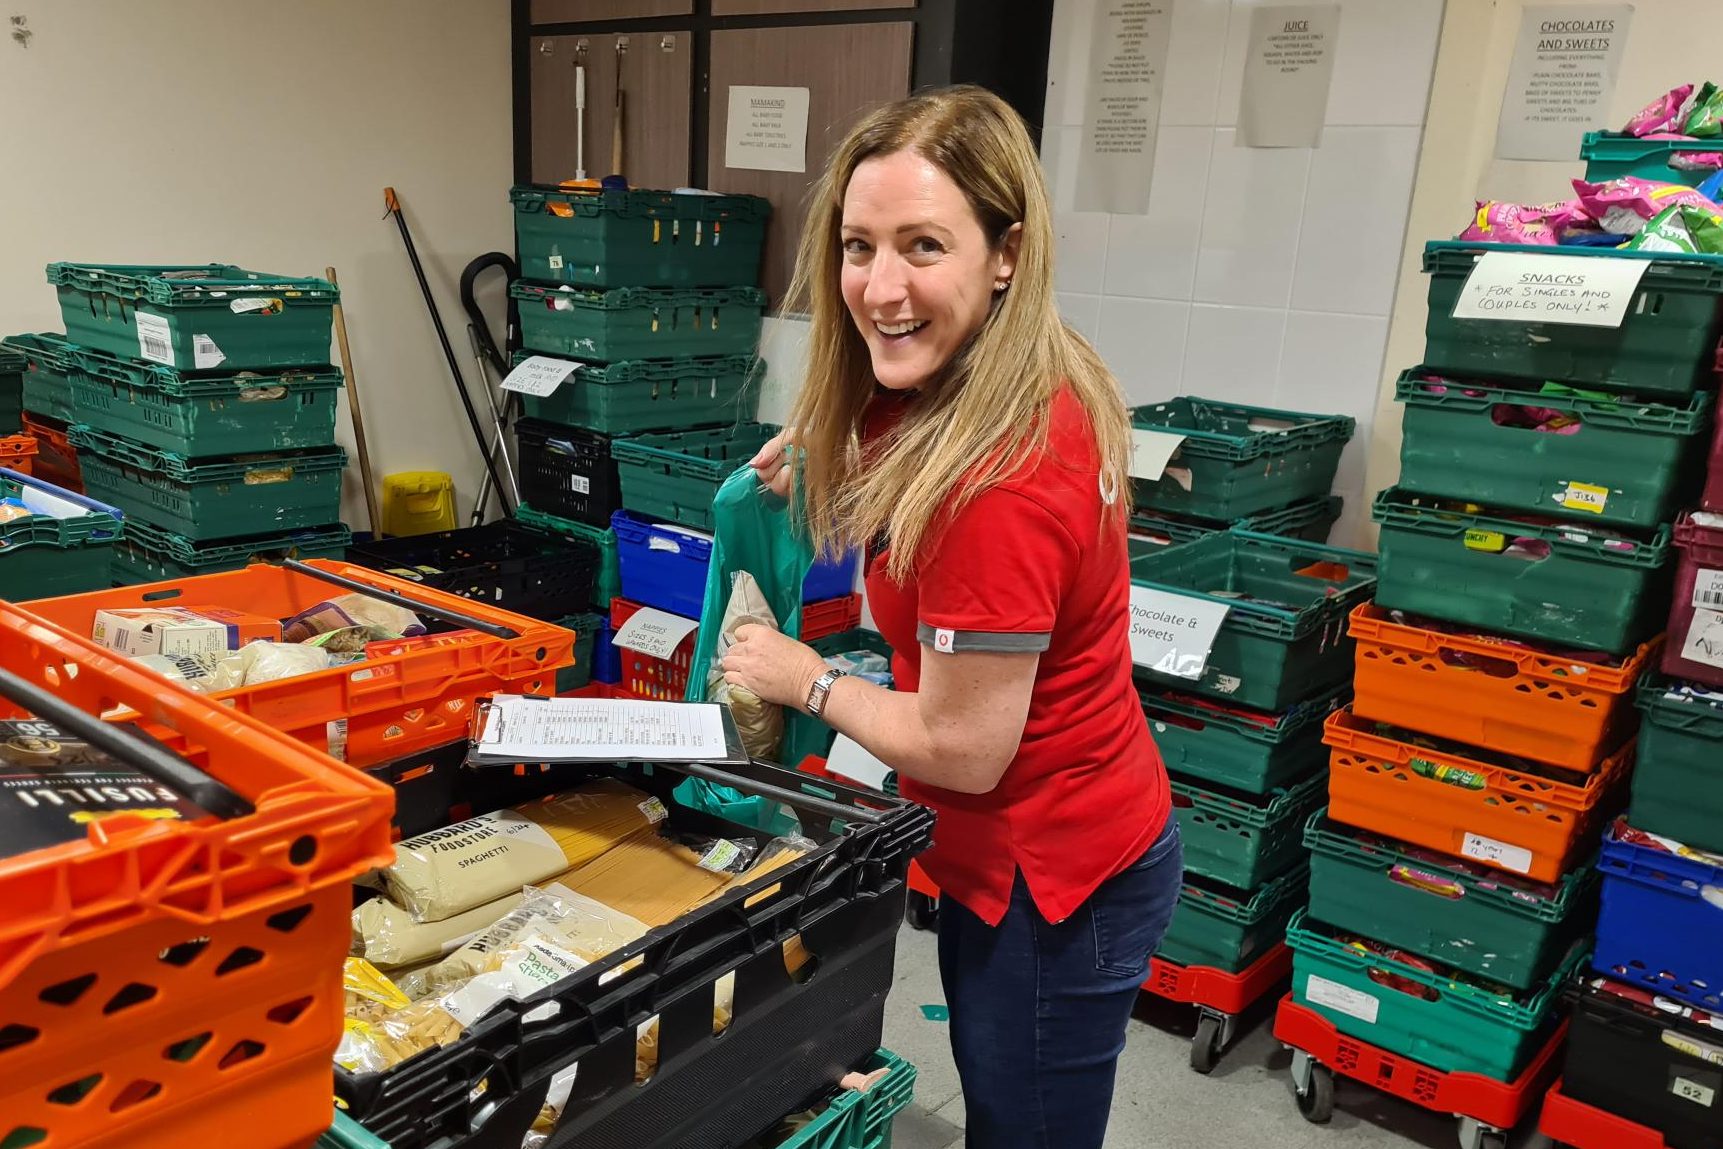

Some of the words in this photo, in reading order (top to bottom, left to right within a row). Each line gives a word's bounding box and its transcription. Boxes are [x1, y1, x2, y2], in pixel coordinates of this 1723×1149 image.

[1284, 20, 1308, 32] JUICE
[1540, 20, 1614, 33] CHOCOLATES
[1537, 38, 1563, 51] AND
[1565, 38, 1610, 51] SWEETS
[1519, 273, 1586, 285] SNACKS
[1486, 285, 1513, 297] FOR
[1521, 286, 1576, 298] SINGLES
[1581, 289, 1611, 299] AND
[1478, 299, 1537, 310] COUPLES
[1129, 603, 1184, 626] hocolate
[1187, 617, 1198, 629] &
[1131, 623, 1175, 642] Sweets
[16, 787, 179, 808] FUSILLI
[430, 826, 499, 854] FOODSTORE
[458, 845, 509, 869] SPAGHETTI
[525, 951, 561, 981] Pasta
[1682, 1085, 1703, 1099] 52
